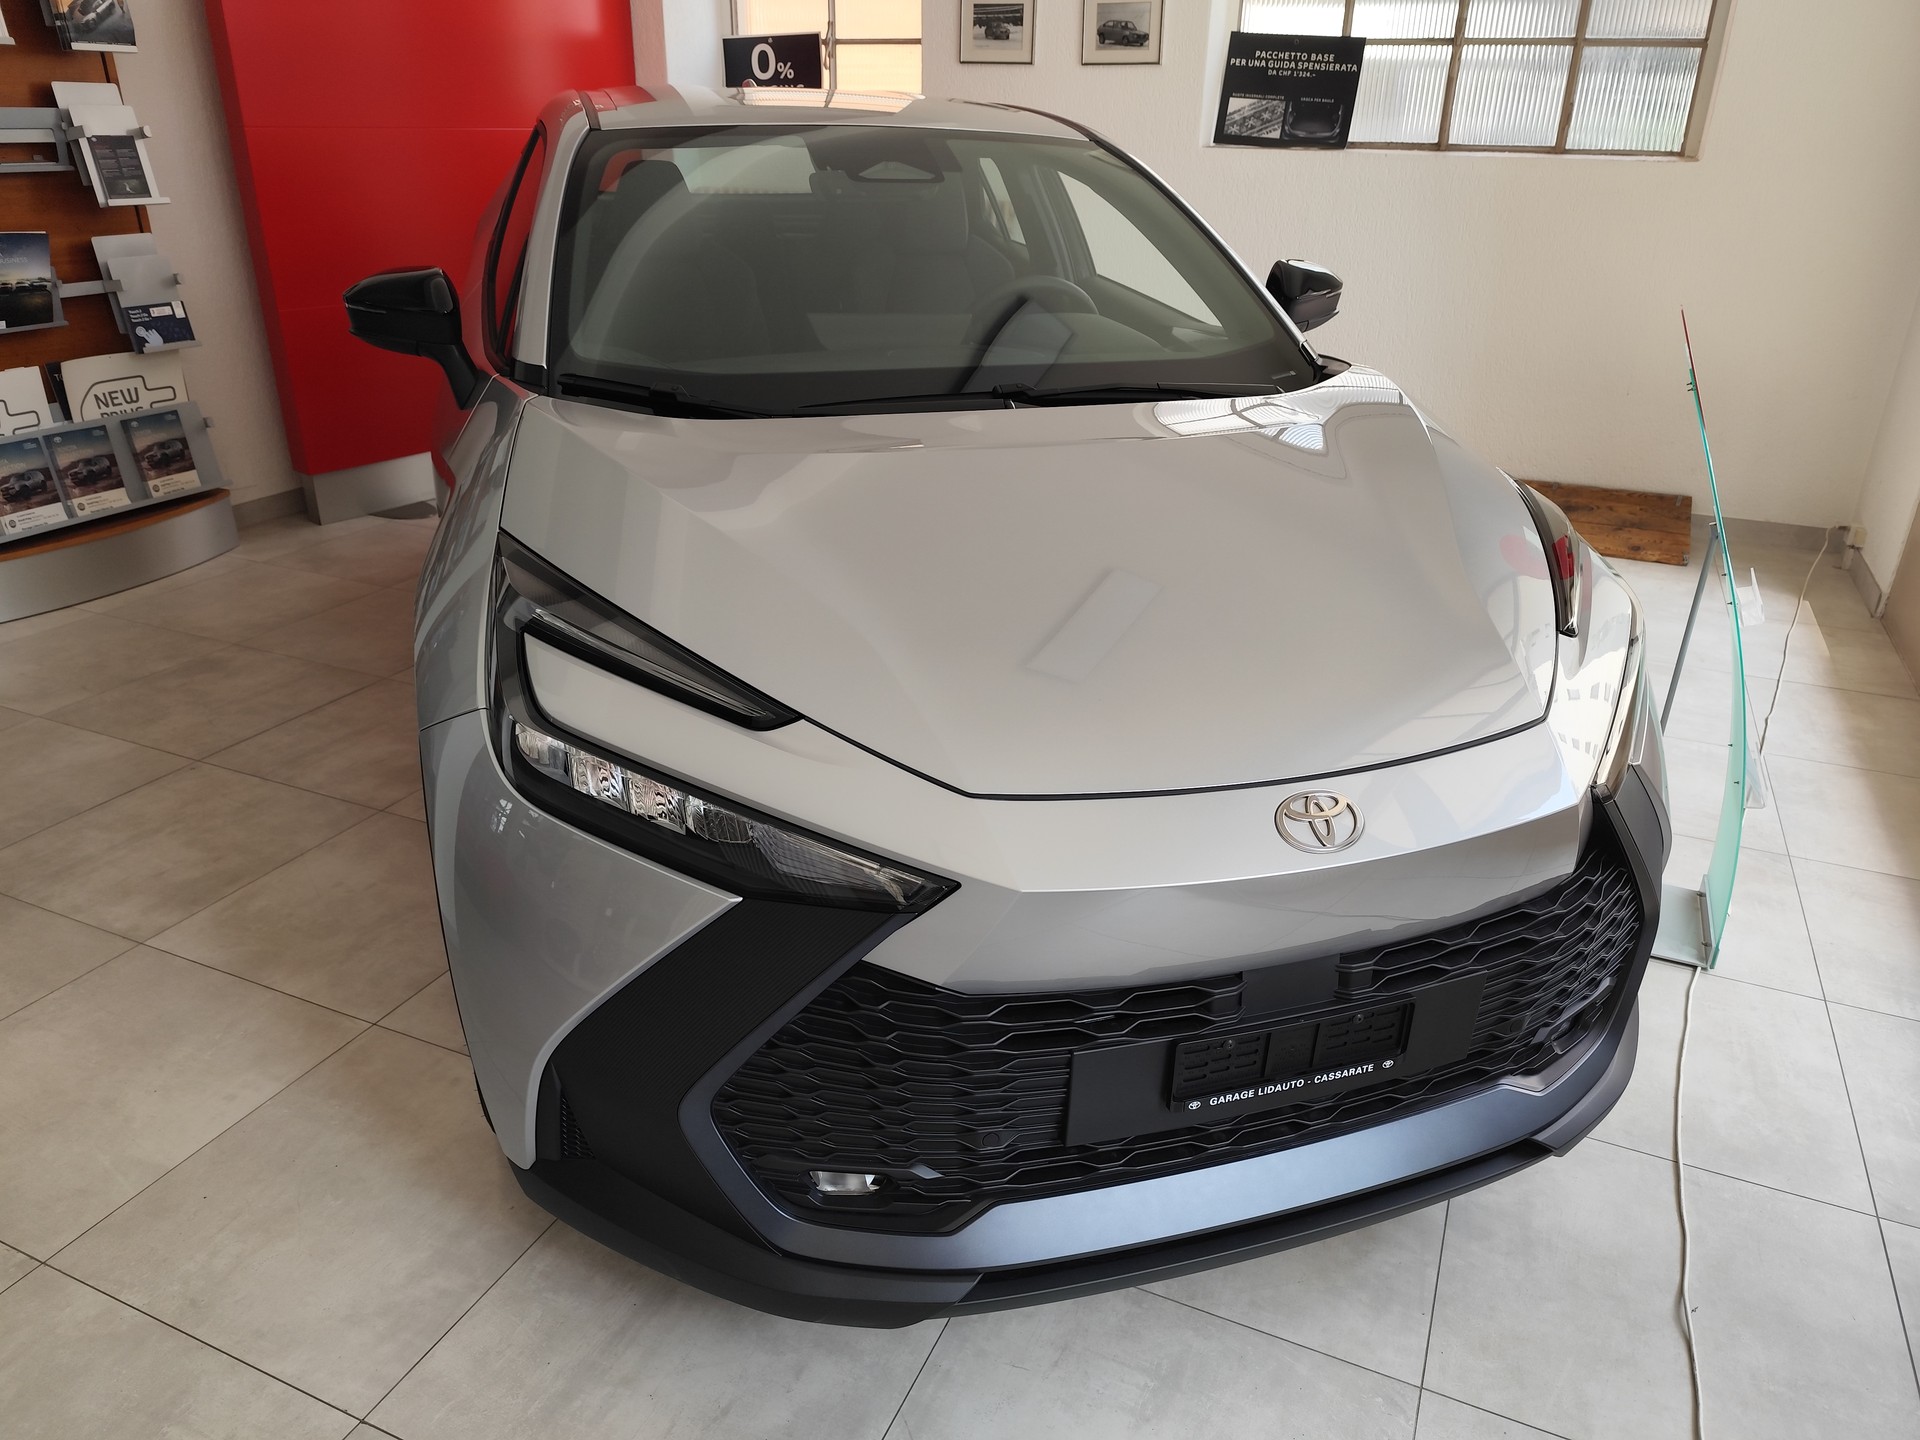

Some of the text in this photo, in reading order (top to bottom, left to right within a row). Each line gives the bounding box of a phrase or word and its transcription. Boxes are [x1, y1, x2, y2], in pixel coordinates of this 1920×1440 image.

[751, 43, 794, 80] 0%
[1230, 58, 1358, 72] PER UNA GUIDA SPENSIERATA
[1255, 51, 1335, 62] PACCHETTO BASE
[93, 387, 140, 410] NEW
[1209, 1089, 1255, 1106] GARAGE
[1258, 1079, 1305, 1096] LIDAUTO
[1314, 1063, 1375, 1084] CASSARATE
